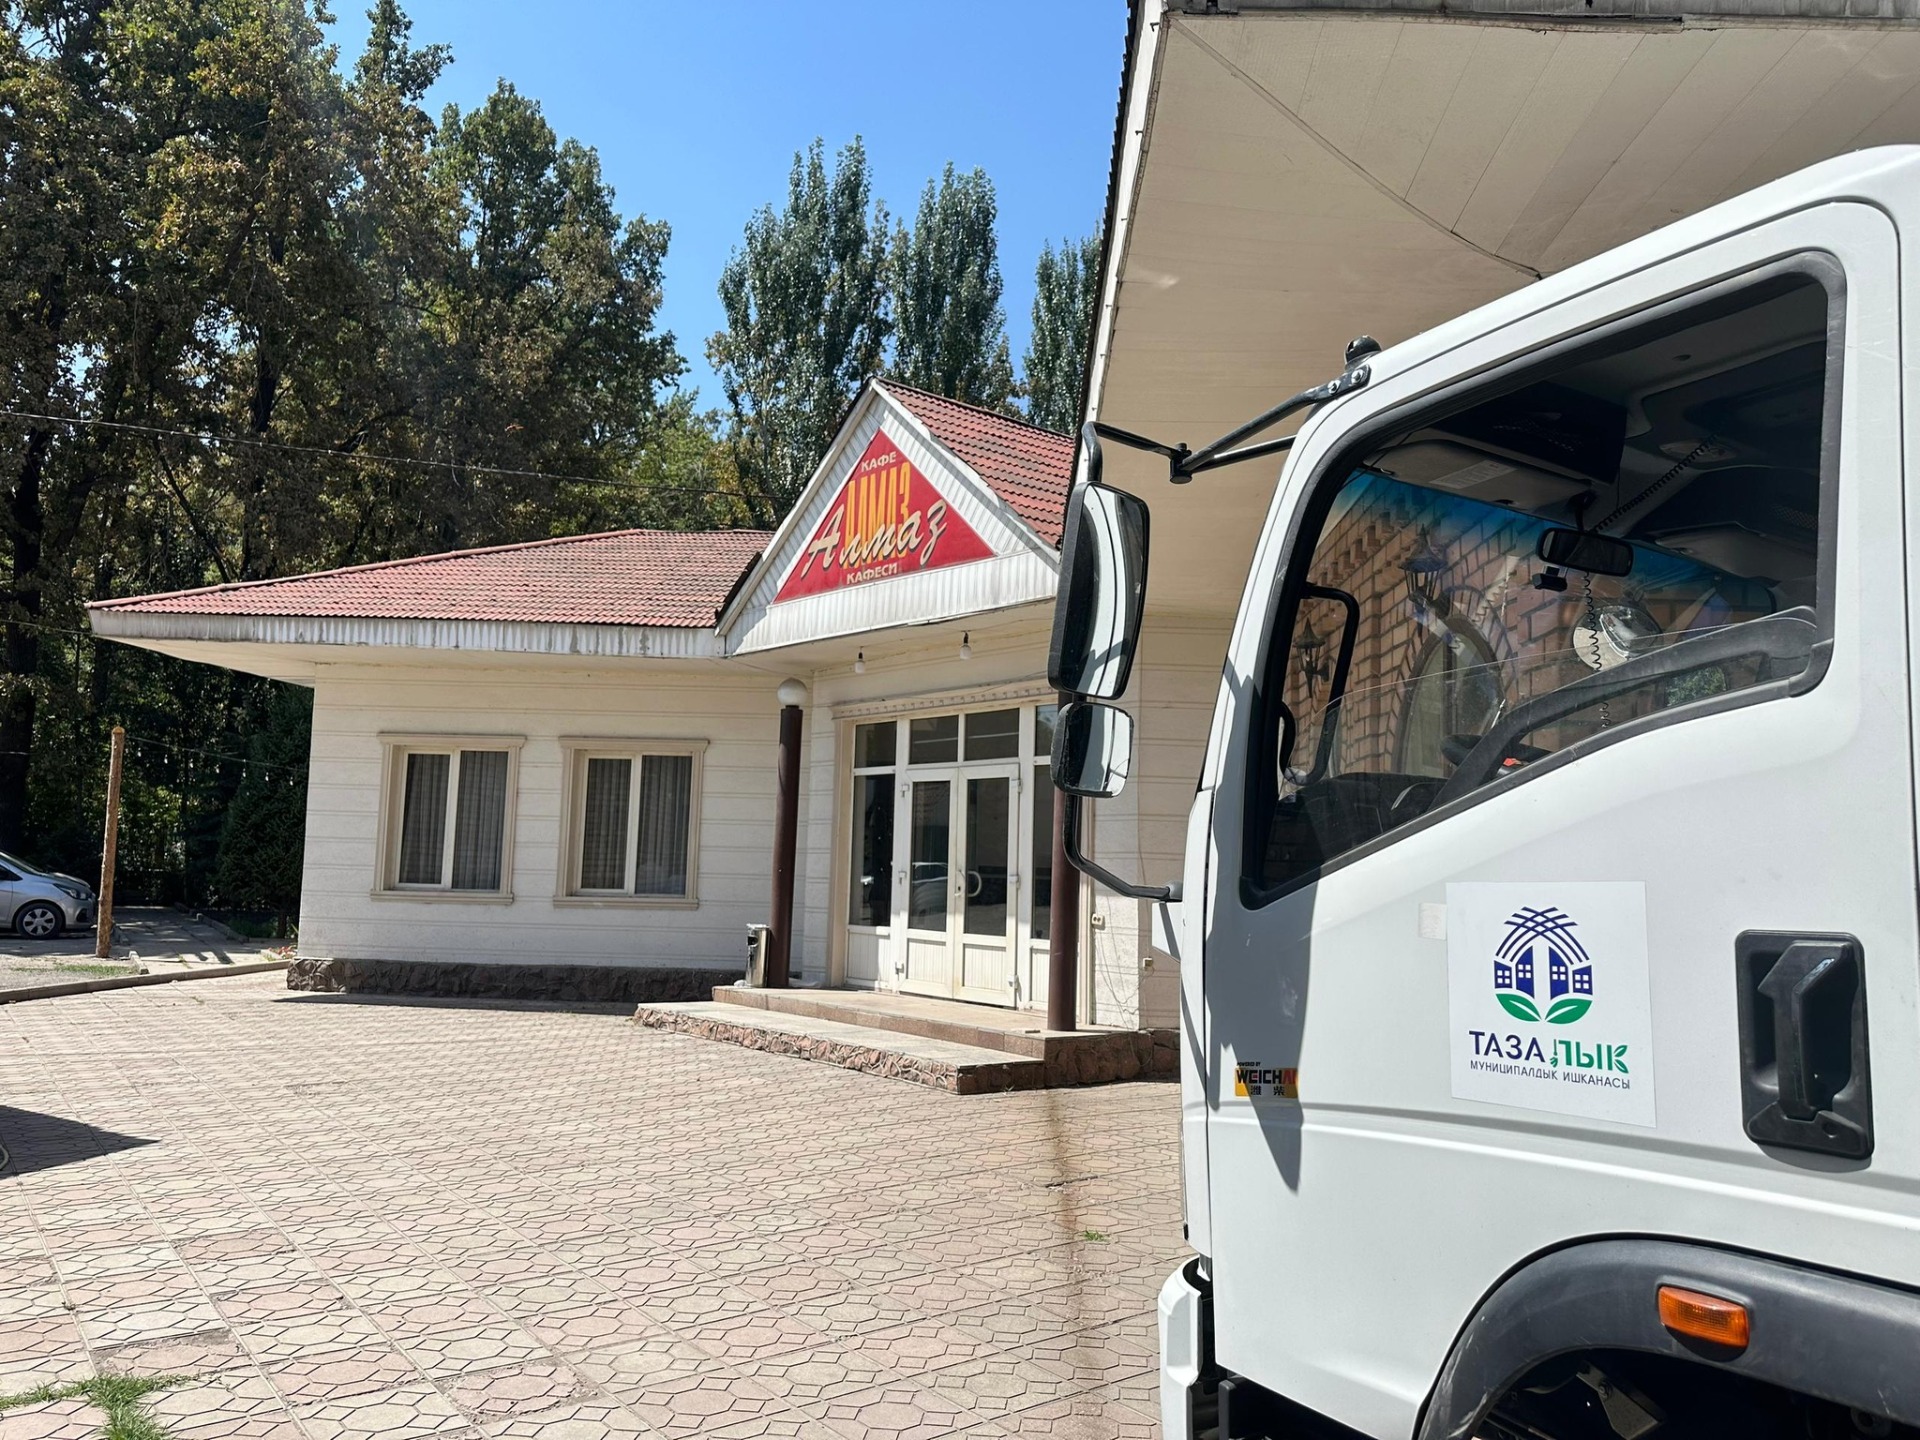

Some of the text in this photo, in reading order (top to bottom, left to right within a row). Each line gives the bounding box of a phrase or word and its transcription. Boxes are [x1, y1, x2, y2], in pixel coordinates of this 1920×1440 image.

[861, 451, 897, 473] КАФЕ
[846, 562, 898, 585] КАФЕСИ
[1236, 1069, 1298, 1084] WEICHAI
[1470, 1060, 1631, 1090] МУНИЦИПАЛДЫК ИШКАНАСЫ
